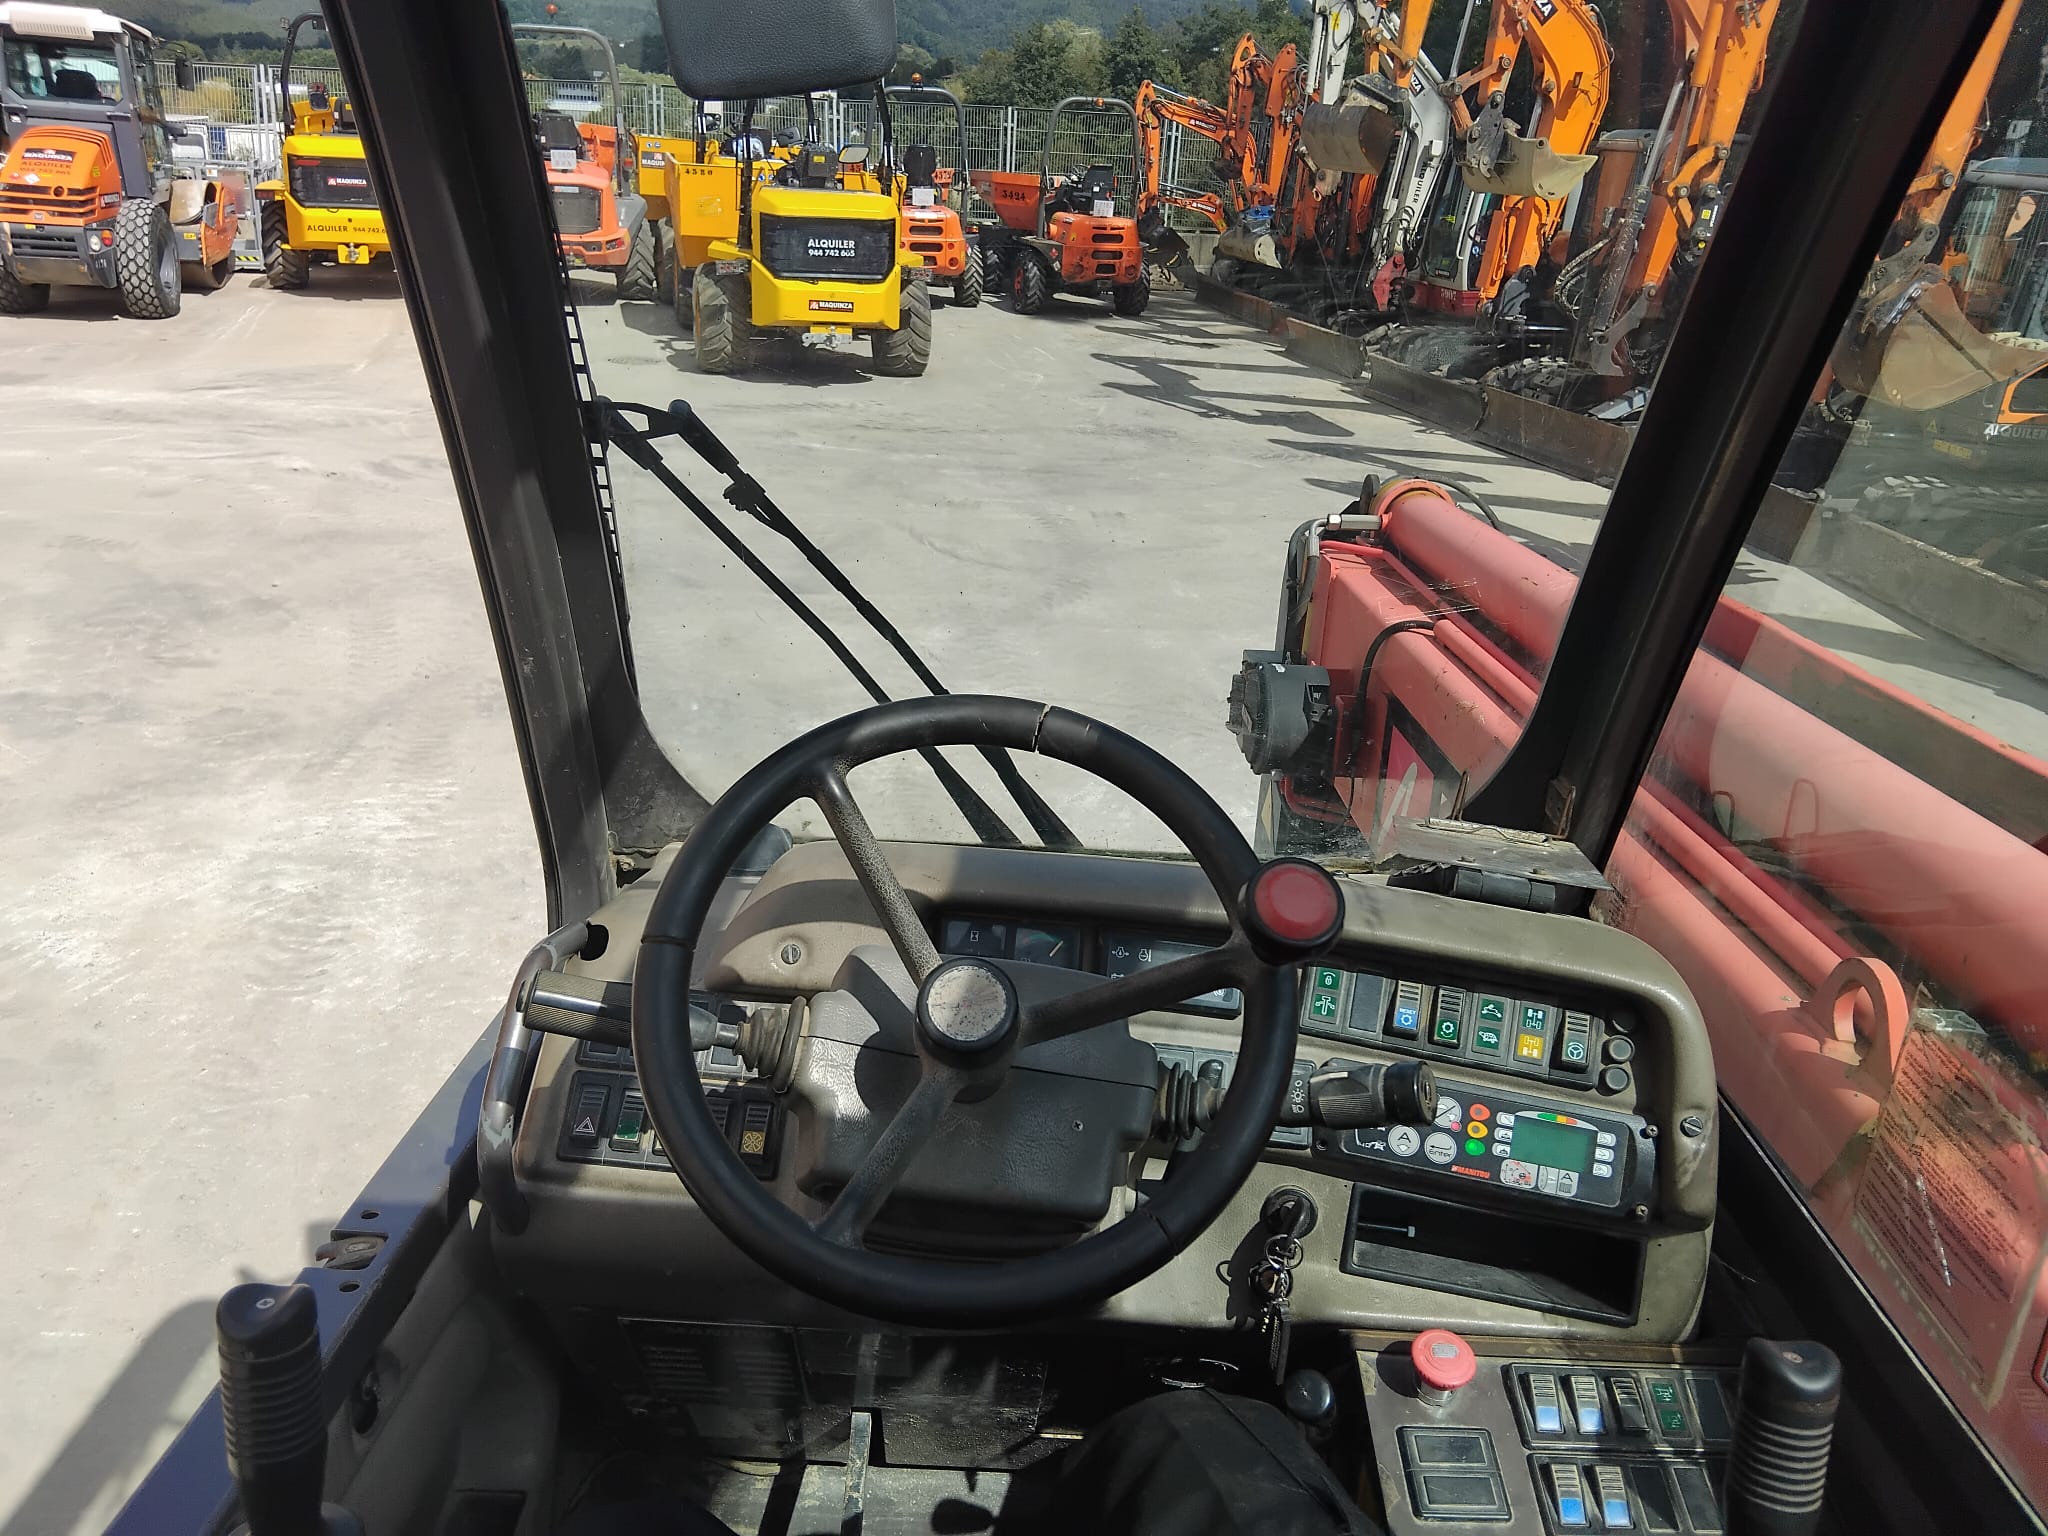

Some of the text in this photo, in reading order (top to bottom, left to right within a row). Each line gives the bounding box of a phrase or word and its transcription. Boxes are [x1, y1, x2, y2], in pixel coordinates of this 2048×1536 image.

[23, 151, 73, 161] MAQUINZA
[22, 161, 72, 169] ALQUILER
[336, 177, 367, 185] MAQUINZA
[1413, 161, 1428, 204] ALQUILER
[307, 225, 348, 233] ALQUILER
[807, 238, 856, 249] ALQUILER
[808, 248, 824, 257] 944
[824, 249, 840, 257] 742
[819, 301, 853, 310] MAQUINZA
